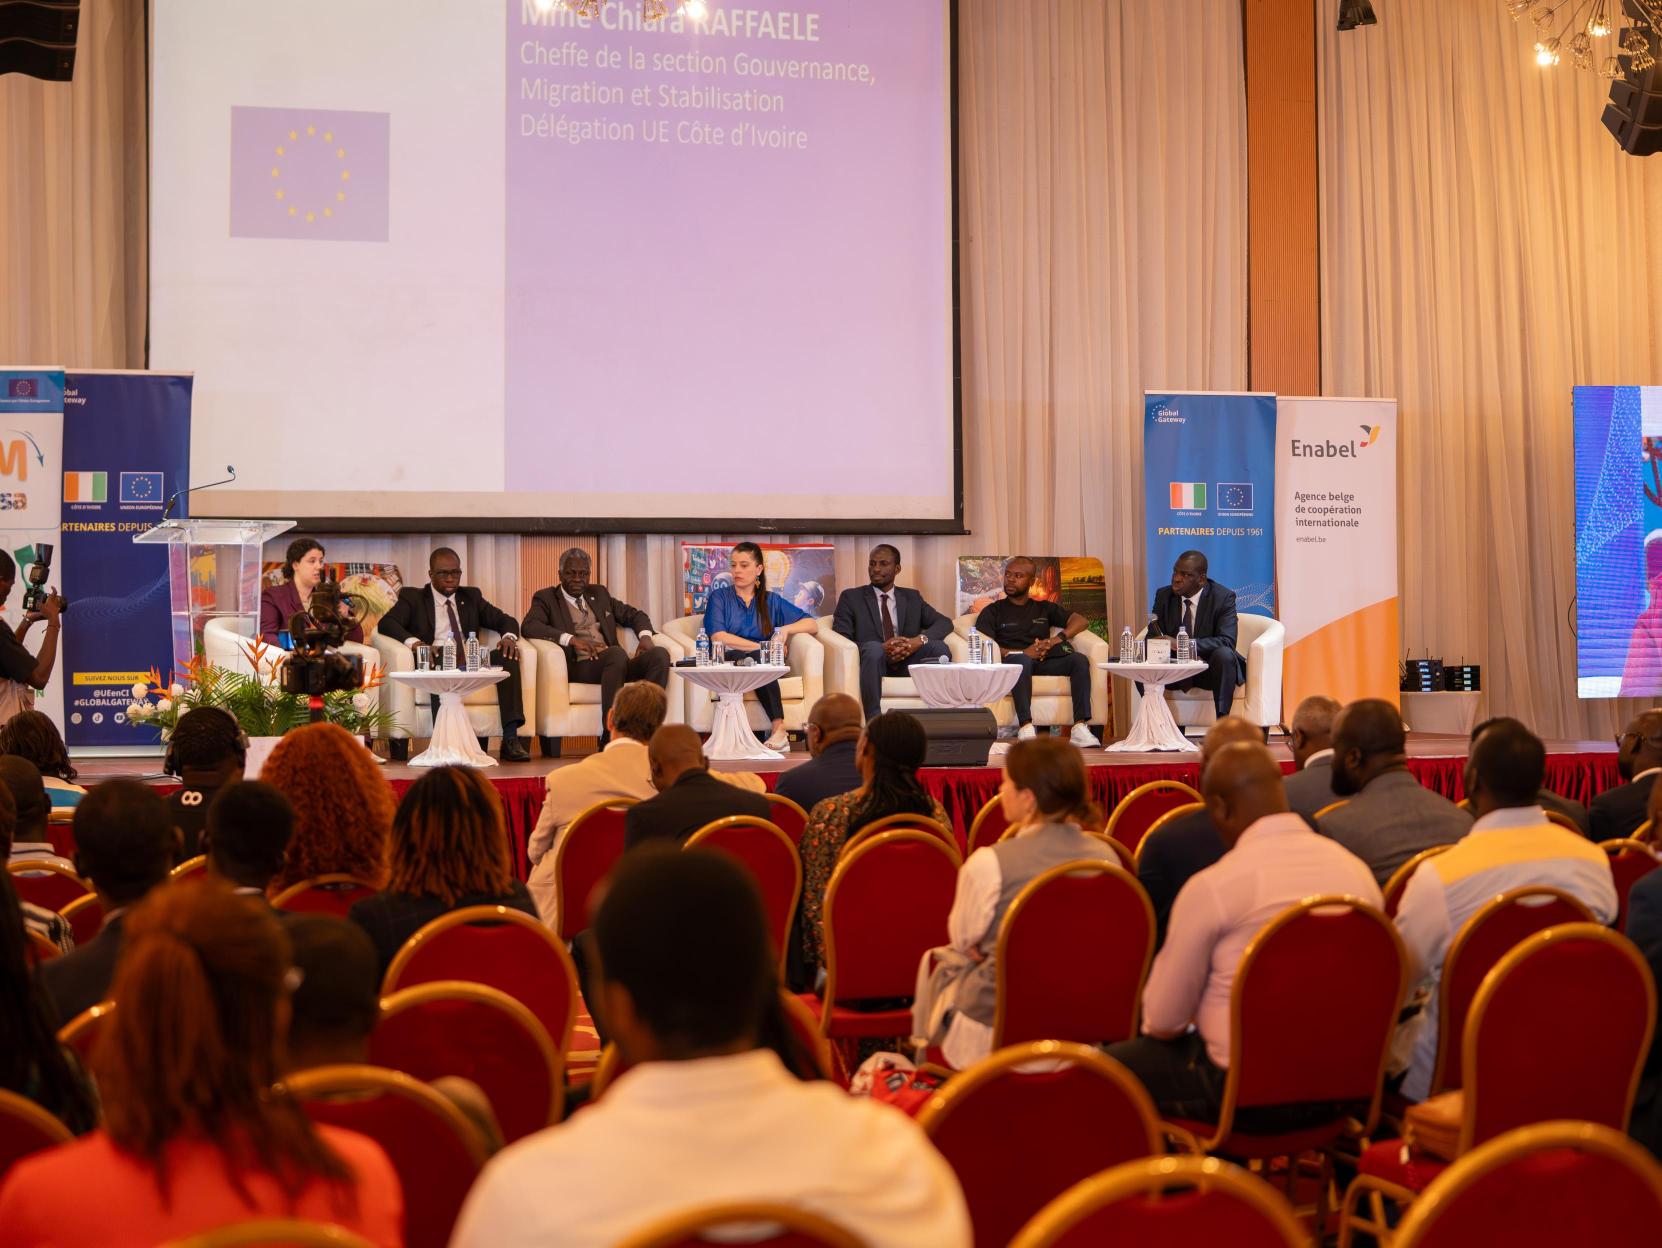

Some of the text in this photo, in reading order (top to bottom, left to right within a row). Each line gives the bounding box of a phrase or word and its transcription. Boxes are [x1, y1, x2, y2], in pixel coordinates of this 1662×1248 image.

[601, 1, 685, 34] Chiara
[520, 41, 875, 85] Cheffe de la section Gouvernance,
[520, 78, 785, 113] Migration et Stabilisation
[521, 113, 634, 148] Délégation
[643, 121, 670, 143] UE
[677, 119, 724, 146] Côte
[64, 397, 87, 406] teway
[1158, 409, 1179, 417] Global
[1158, 416, 1186, 424] Gateway
[1291, 439, 1357, 458] Enabel
[1294, 491, 1355, 503] Agence belge
[1295, 504, 1362, 516] de coopération
[61, 522, 116, 532] RTENAIRES
[1295, 518, 1359, 528] internationale
[1158, 527, 1263, 536] PARTENAIRES DEPUIS 1961
[1296, 535, 1327, 543] enabel.be
[93, 689, 130, 698] @UEenCI
